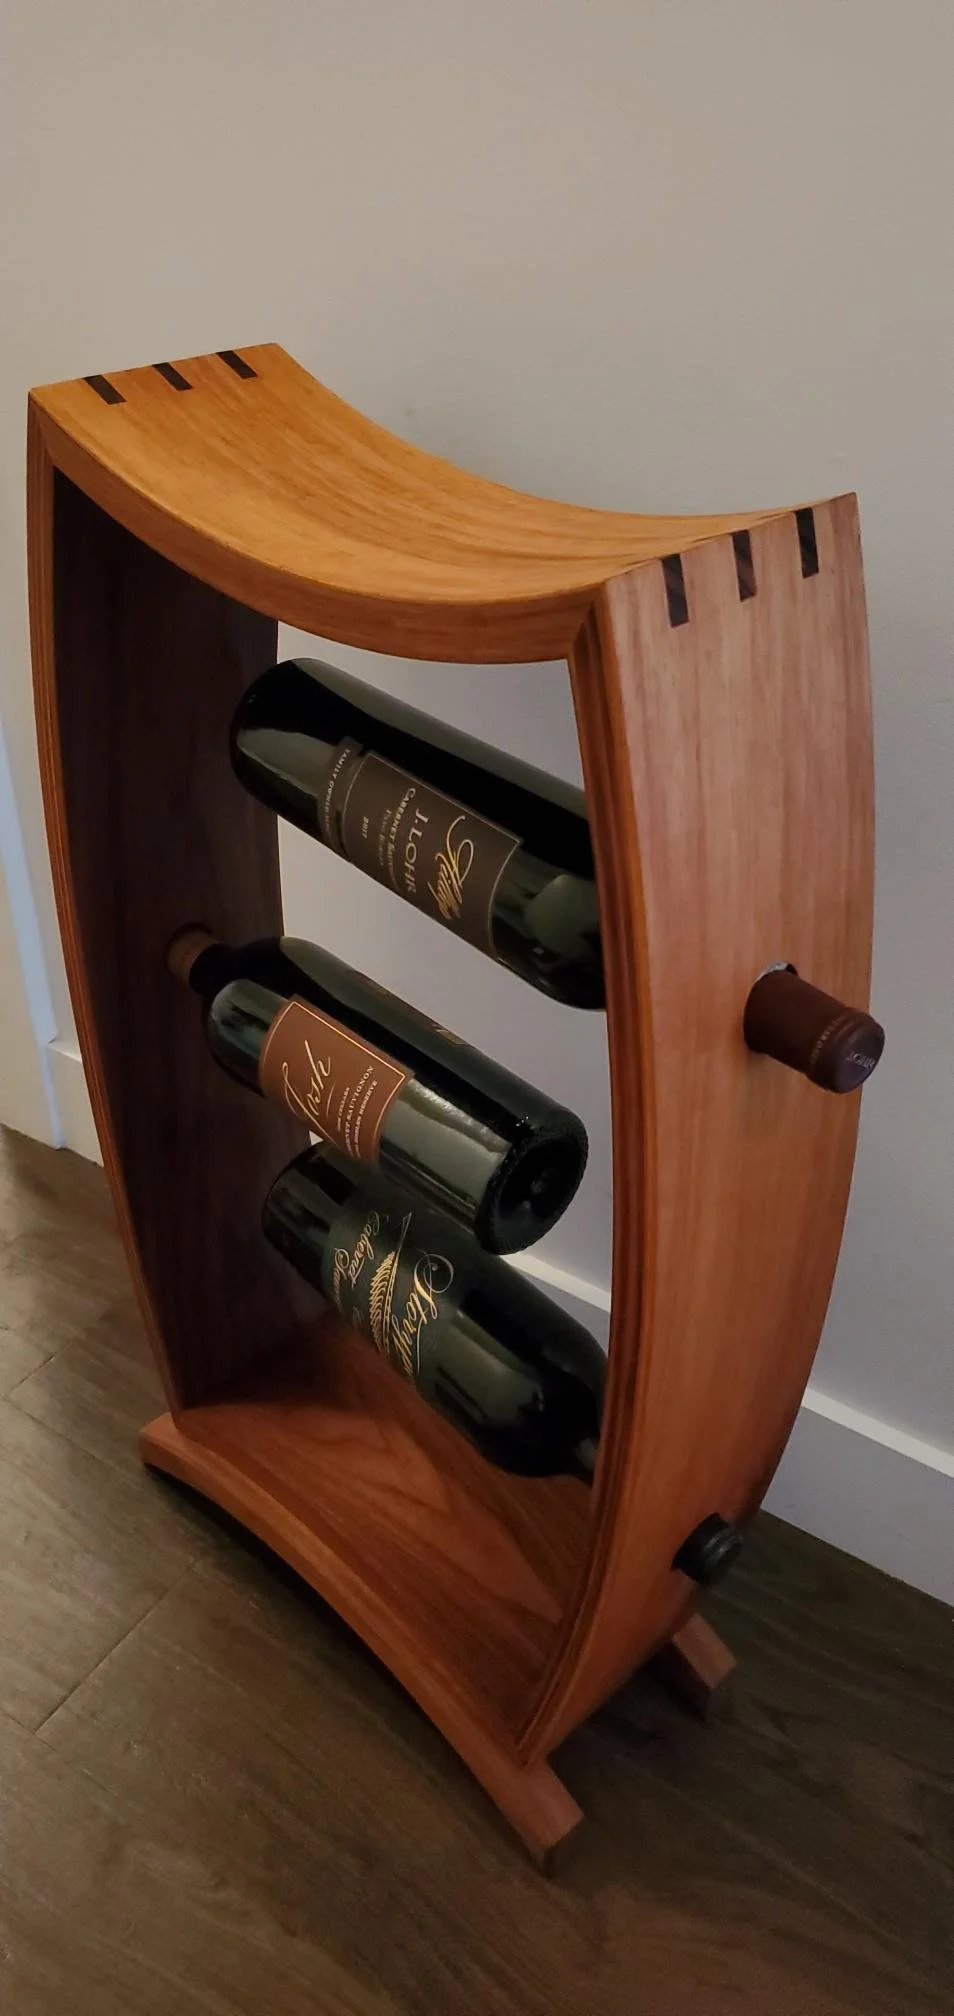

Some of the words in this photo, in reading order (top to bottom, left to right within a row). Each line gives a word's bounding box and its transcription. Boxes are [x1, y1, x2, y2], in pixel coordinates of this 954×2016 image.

[332, 748, 351, 779] FAMILY
[390, 787, 416, 841] CABERNET
[404, 826, 423, 894] LOHR
[282, 1039, 341, 1149] Josh
[346, 1065, 375, 1121] SAUVIGNON
[349, 1211, 380, 1290] Cabernet
